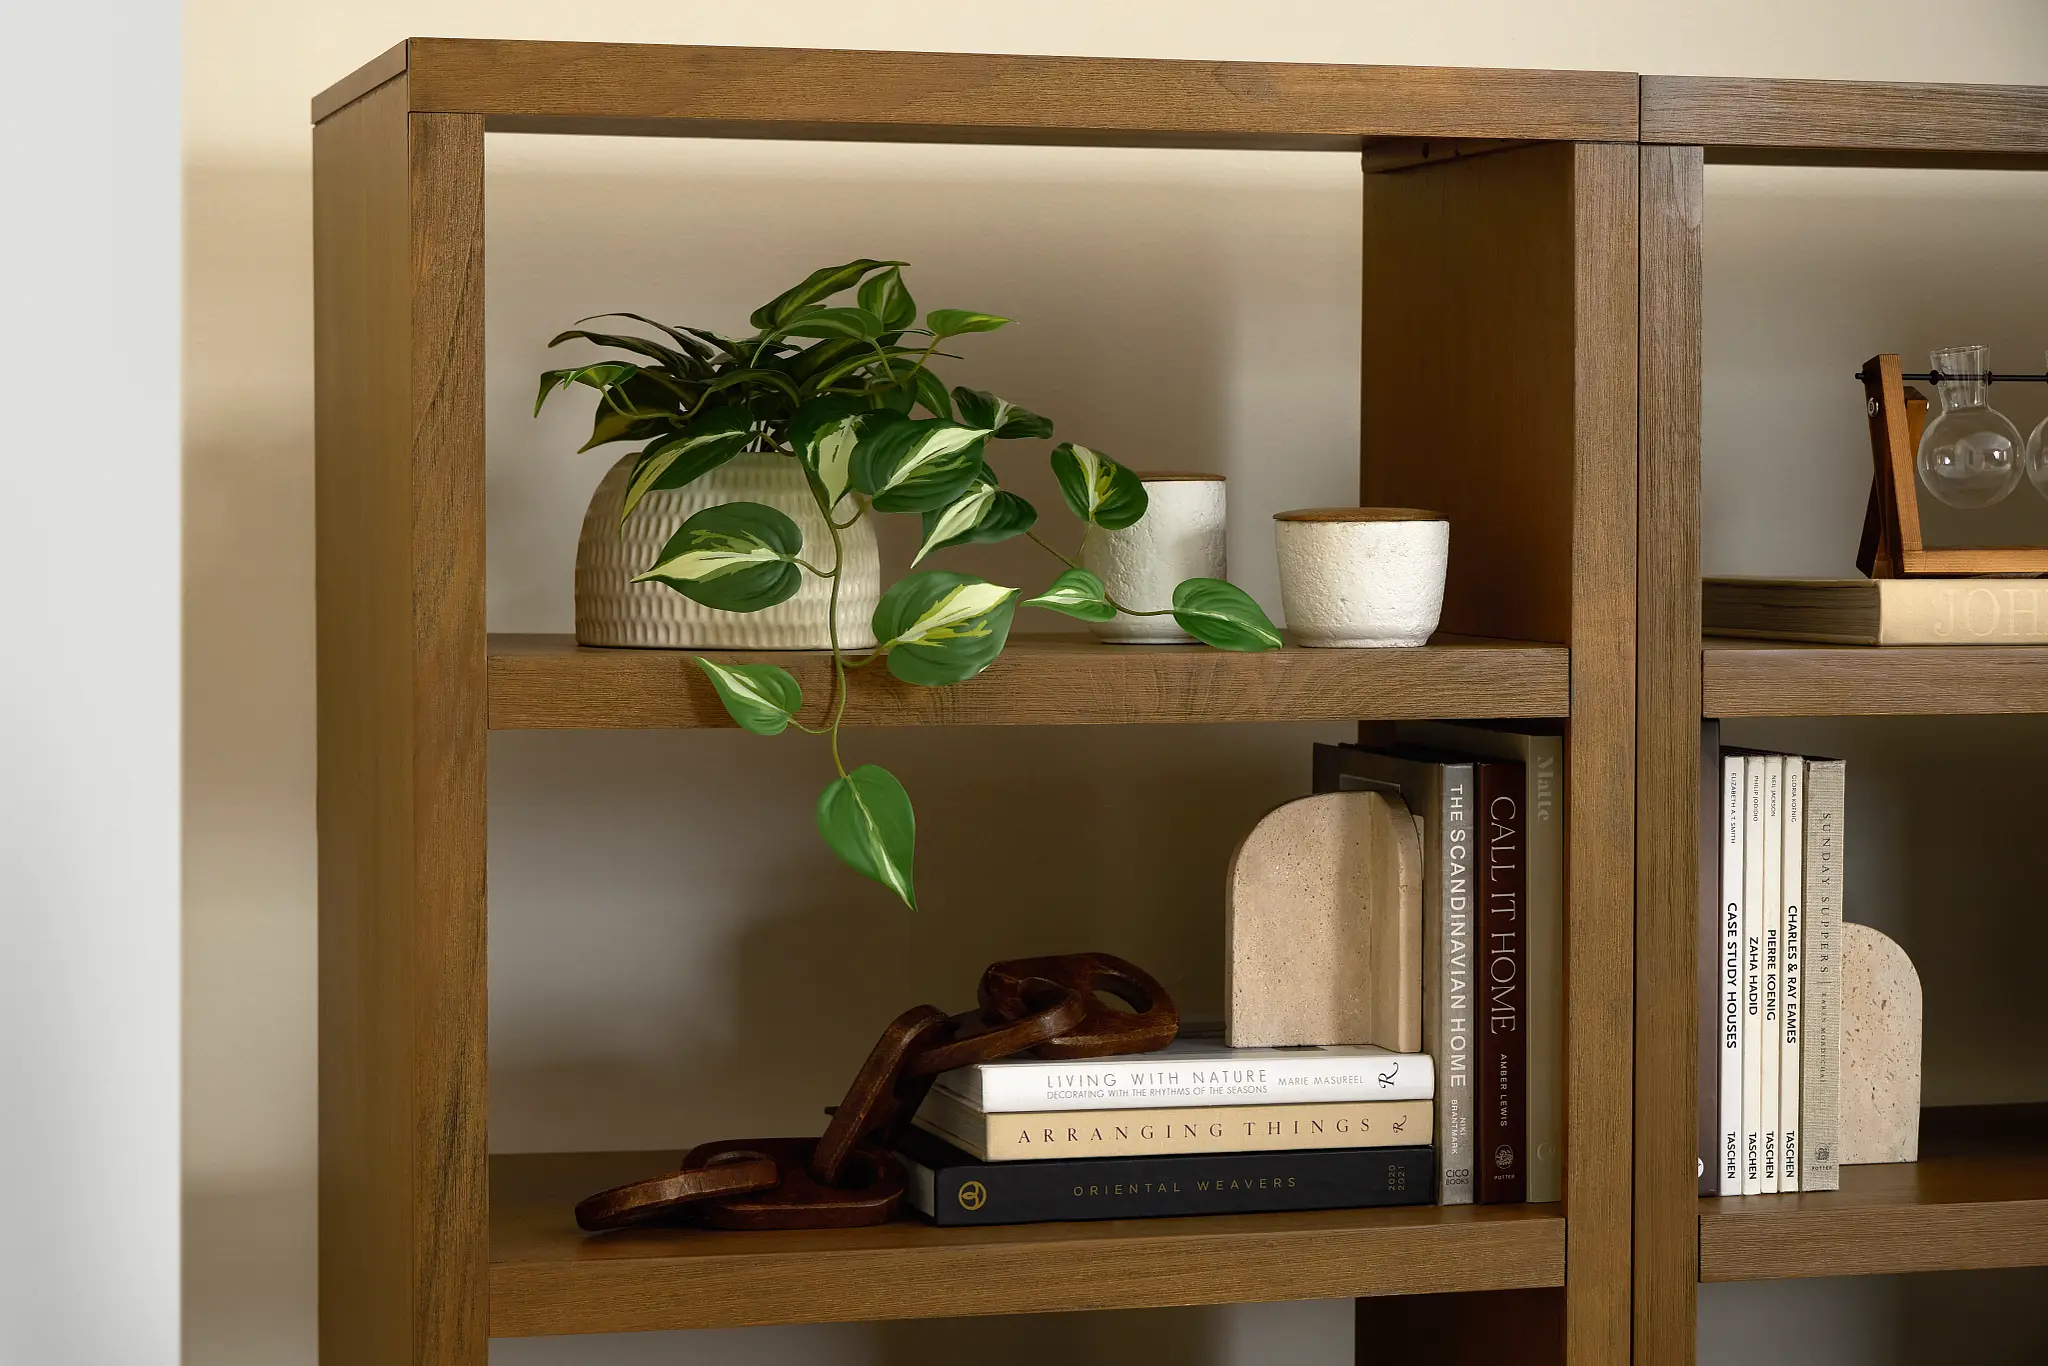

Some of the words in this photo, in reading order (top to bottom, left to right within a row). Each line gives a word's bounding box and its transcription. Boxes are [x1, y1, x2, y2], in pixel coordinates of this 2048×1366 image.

[1933, 588, 2048, 636] JOH
[1450, 784, 1463, 822] THE
[1490, 796, 1516, 882] CALL
[1821, 813, 1831, 885] SUNDAY
[1450, 829, 1466, 1009] SCANDINAVIAN
[1491, 892, 1516, 921] IT
[1727, 902, 1737, 938] CASE
[1767, 929, 1776, 970] PIERRE
[1787, 905, 1798, 960] CHARLES
[1820, 896, 1830, 973] SUPPERS
[1727, 941, 1737, 987] STUDY
[1749, 936, 1759, 971] ZAHA
[1787, 963, 1798, 973] &
[1490, 932, 1516, 1035] HOME
[1749, 975, 1758, 1016] HADID
[1766, 973, 1776, 1021] KOENIG
[1787, 976, 1797, 999] RAY
[1726, 991, 1737, 1049] HOUSES
[1786, 1003, 1797, 1044] EAMES
[1450, 1018, 1466, 1088] HOME
[1500, 1053, 1508, 1090] AMBER
[1046, 1089, 1104, 1100] DECORATING
[1108, 1088, 1129, 1098] WITH
[1132, 1088, 1147, 1097] THE
[1150, 1087, 1190, 1097] RHYTHMS
[1193, 1086, 1206, 1096] OF
[1209, 1086, 1224, 1095] THE
[1227, 1085, 1268, 1095] SEASONS
[1047, 1073, 1117, 1088] LIVING
[1131, 1071, 1180, 1086] WITH
[1193, 1069, 1268, 1085] NATURE
[1278, 1076, 1309, 1086] MARIE
[1313, 1075, 1363, 1085] MASUREEL
[1017, 1123, 1223, 1144] ARRANGING
[1243, 1117, 1370, 1136] THINGS
[1500, 1094, 1508, 1127] LEWIS
[1445, 1168, 1469, 1178] CICO
[1727, 1131, 1736, 1179] TASCHEN
[1748, 1131, 1757, 1180] TASCHEN
[1765, 1130, 1774, 1179] TASCHEN
[1786, 1130, 1795, 1178] TASCHEN
[1073, 1181, 1181, 1197] ORIENTAL
[1196, 1176, 1296, 1192] WEAVERS
[1388, 1164, 1396, 1191] 2020
[1397, 1165, 1405, 1191] 2021
